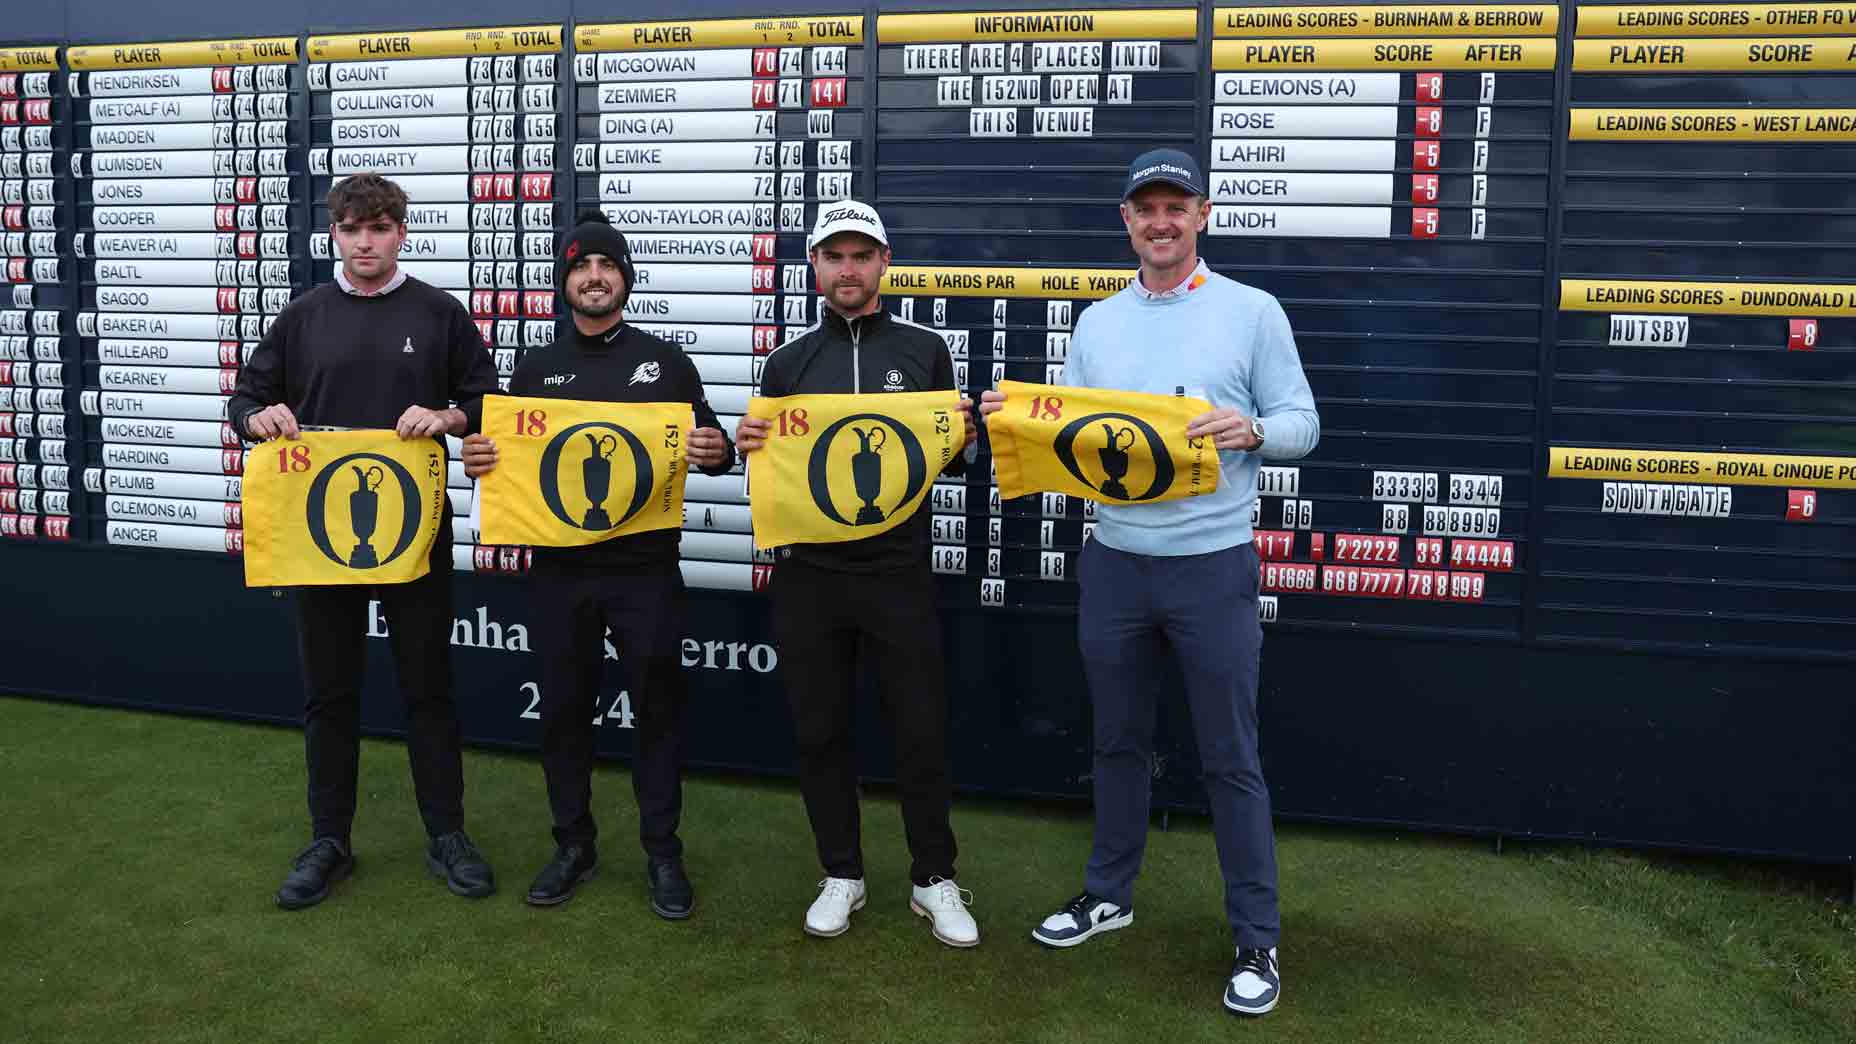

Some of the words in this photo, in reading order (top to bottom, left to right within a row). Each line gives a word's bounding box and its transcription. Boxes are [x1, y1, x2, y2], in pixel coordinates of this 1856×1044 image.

[975, 16, 1093, 33] INFORMATION
[1227, 13, 1292, 27] LEADING
[1298, 13, 1358, 27] SCORES
[1375, 12, 1452, 27] BURNHAM
[1459, 12, 1469, 26] &
[1475, 11, 1543, 26] BERROW
[1618, 12, 1683, 26] LEADING
[1688, 11, 1749, 25] SCORES
[1766, 10, 1818, 25] OTHER
[1823, 10, 1843, 25] FQ
[359, 38, 410, 53] PLAYER
[512, 31, 555, 47] TOTAL
[634, 27, 692, 44] PLAYER
[808, 22, 855, 38] TOTAL
[16, 52, 50, 65] TOTAL
[114, 48, 161, 64] PLAYER
[252, 43, 290, 57] TOTAL
[603, 57, 695, 74] MCGOWAN
[756, 52, 775, 73] 70
[782, 51, 800, 72] 74
[815, 50, 844, 71] 144
[907, 48, 959, 69] THERE
[970, 47, 1003, 68] ARE
[1011, 47, 1021, 67] 4
[1034, 46, 1101, 67] PLACES
[1115, 45, 1158, 66] INTO
[1246, 47, 1315, 62] PLAYER
[1375, 45, 1432, 61] SCORE
[1465, 45, 1521, 61] AFTER
[1610, 46, 1684, 64] PLAYER
[1749, 44, 1813, 62] SCORE
[336, 67, 388, 81] GAUNT
[473, 59, 490, 78] 73
[496, 58, 513, 77] 73
[526, 57, 553, 77] 146
[93, 73, 180, 91] HENDRIKSEN
[941, 80, 971, 101] THE
[985, 79, 1039, 100] 152ND
[1053, 79, 1097, 99] OPEN
[1109, 78, 1130, 99] AT
[1223, 80, 1323, 96] CLEMONS
[1329, 79, 1356, 98] (A)
[1419, 77, 1440, 98] -8
[1483, 78, 1492, 98] F
[337, 95, 434, 111] CULLINGTON
[525, 87, 551, 107] 151
[604, 88, 676, 104] ZEMMER
[814, 82, 843, 102] 141
[95, 102, 161, 118] METCALF
[162, 100, 181, 117] (A)
[338, 125, 400, 139] BOSTON
[527, 118, 553, 137] 155
[605, 119, 647, 133] DING
[651, 118, 673, 135] (A)
[809, 114, 830, 134] WD
[972, 112, 1015, 133] THIS
[1035, 112, 1091, 132] VENUE
[1220, 113, 1274, 129] ROSE
[1418, 112, 1439, 133] -8
[1479, 112, 1488, 132] F
[1597, 116, 1666, 131] LEADING
[1671, 116, 1736, 131] SCORES
[1754, 116, 1800, 132] WEST
[96, 129, 155, 145] MADDEN
[97, 156, 162, 172] LUMSDEN
[338, 153, 416, 168] MORIARTY
[525, 148, 551, 167] 145
[605, 149, 662, 164] LEMKE
[820, 145, 849, 165] 154
[1220, 147, 1285, 162] LAHIRI
[1416, 145, 1438, 166] -5
[1477, 145, 1486, 166] F
[1160, 163, 1191, 179] Stanley
[98, 184, 143, 199] JONES
[523, 177, 549, 195] 137
[605, 180, 631, 194] ALI
[820, 176, 849, 195] 151
[1218, 180, 1287, 195] ANCER
[1415, 179, 1436, 200] -5
[1476, 180, 1484, 200] F
[99, 211, 155, 225] COOPER
[525, 207, 551, 226] 145
[728, 208, 751, 226] (A)
[821, 207, 876, 227] Titleist
[1216, 213, 1276, 228] LINDH
[1416, 212, 1436, 233] -5
[1474, 213, 1483, 233] F
[100, 239, 156, 252] WEAVER
[158, 238, 177, 254] (A)
[416, 239, 436, 255] (A)
[525, 236, 551, 255] 158
[100, 265, 142, 279] BALTL
[526, 266, 552, 285] 149
[890, 275, 926, 288] HOLE
[935, 275, 981, 289] YARDS
[987, 276, 1015, 289] PAR
[1042, 276, 1079, 290] HOLE
[101, 292, 149, 306] SAGOO
[1587, 287, 1654, 303] LEADING
[1659, 289, 1723, 305] SCORES
[1741, 291, 1843, 308] DUNDONALD
[936, 302, 943, 322] 3
[995, 304, 1003, 322] 4
[1051, 306, 1069, 325] 10
[103, 319, 148, 331] BAKER
[149, 319, 168, 333] (A)
[1612, 319, 1687, 343] HUTSBY
[1791, 323, 1815, 346] -8
[103, 345, 168, 359] HILLEARD
[105, 372, 168, 385] KEARNEY
[106, 399, 143, 411] RUTH
[1028, 396, 1062, 421] 18
[106, 425, 175, 439] MCKENZIE
[513, 409, 547, 437] 18
[777, 408, 809, 437] 18
[934, 411, 950, 435] 152
[664, 424, 679, 449] 152
[108, 450, 169, 465] HARDING
[278, 445, 311, 474] 18
[1565, 456, 1632, 472] LEADING
[1637, 458, 1699, 475] SCORES
[1716, 461, 1768, 477] ROYAL
[1773, 464, 1833, 480] CINQUE
[110, 477, 155, 490] PLUMB
[111, 501, 176, 517] CLEMONS
[178, 504, 197, 520] (A)
[933, 489, 962, 512] 451
[991, 493, 1000, 510] 4
[1045, 495, 1063, 519] 16
[1605, 487, 1729, 513] SOUTHGATE
[1791, 495, 1813, 516] -6
[112, 527, 158, 542] ANCER
[933, 520, 963, 543] 516
[991, 523, 999, 541] 5
[934, 550, 964, 570] 182
[990, 553, 998, 572] 3
[1043, 556, 1062, 577] 18
[983, 583, 1002, 602] 36
